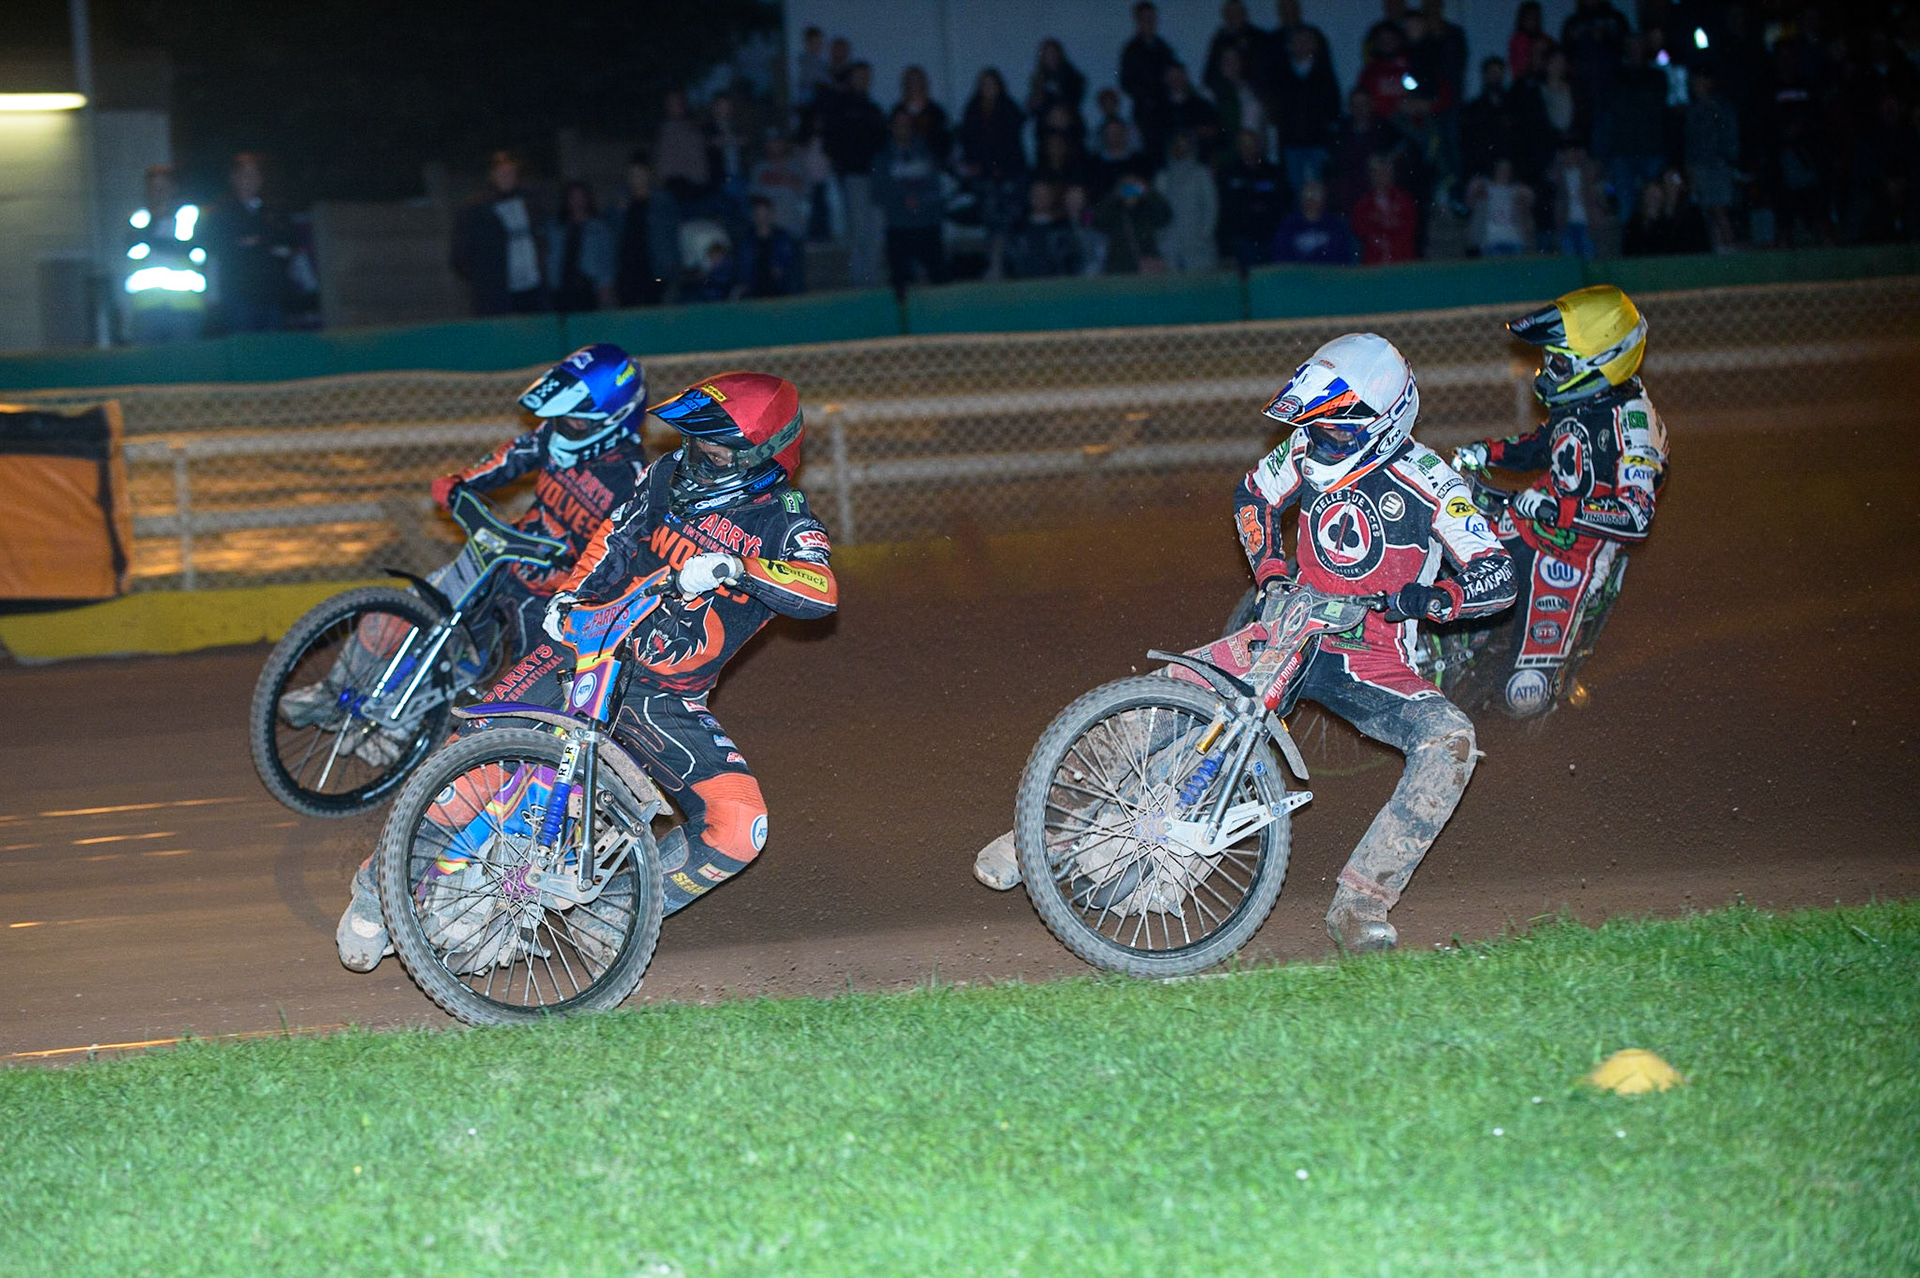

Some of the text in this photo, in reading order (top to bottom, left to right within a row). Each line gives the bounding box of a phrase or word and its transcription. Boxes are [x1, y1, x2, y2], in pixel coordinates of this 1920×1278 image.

[535, 467, 600, 540] WOLVES
[753, 473, 778, 491] SHOEI
[692, 513, 762, 558] ARRYS
[1315, 491, 1343, 514] BELLE
[1365, 509, 1381, 537] ACES
[482, 644, 554, 703] PARRYS
[504, 655, 564, 703] TERNATIONAL
[1268, 676, 1285, 698] BLUE
[1281, 656, 1299, 682] DOOR
[1514, 685, 1540, 699] ATPI
